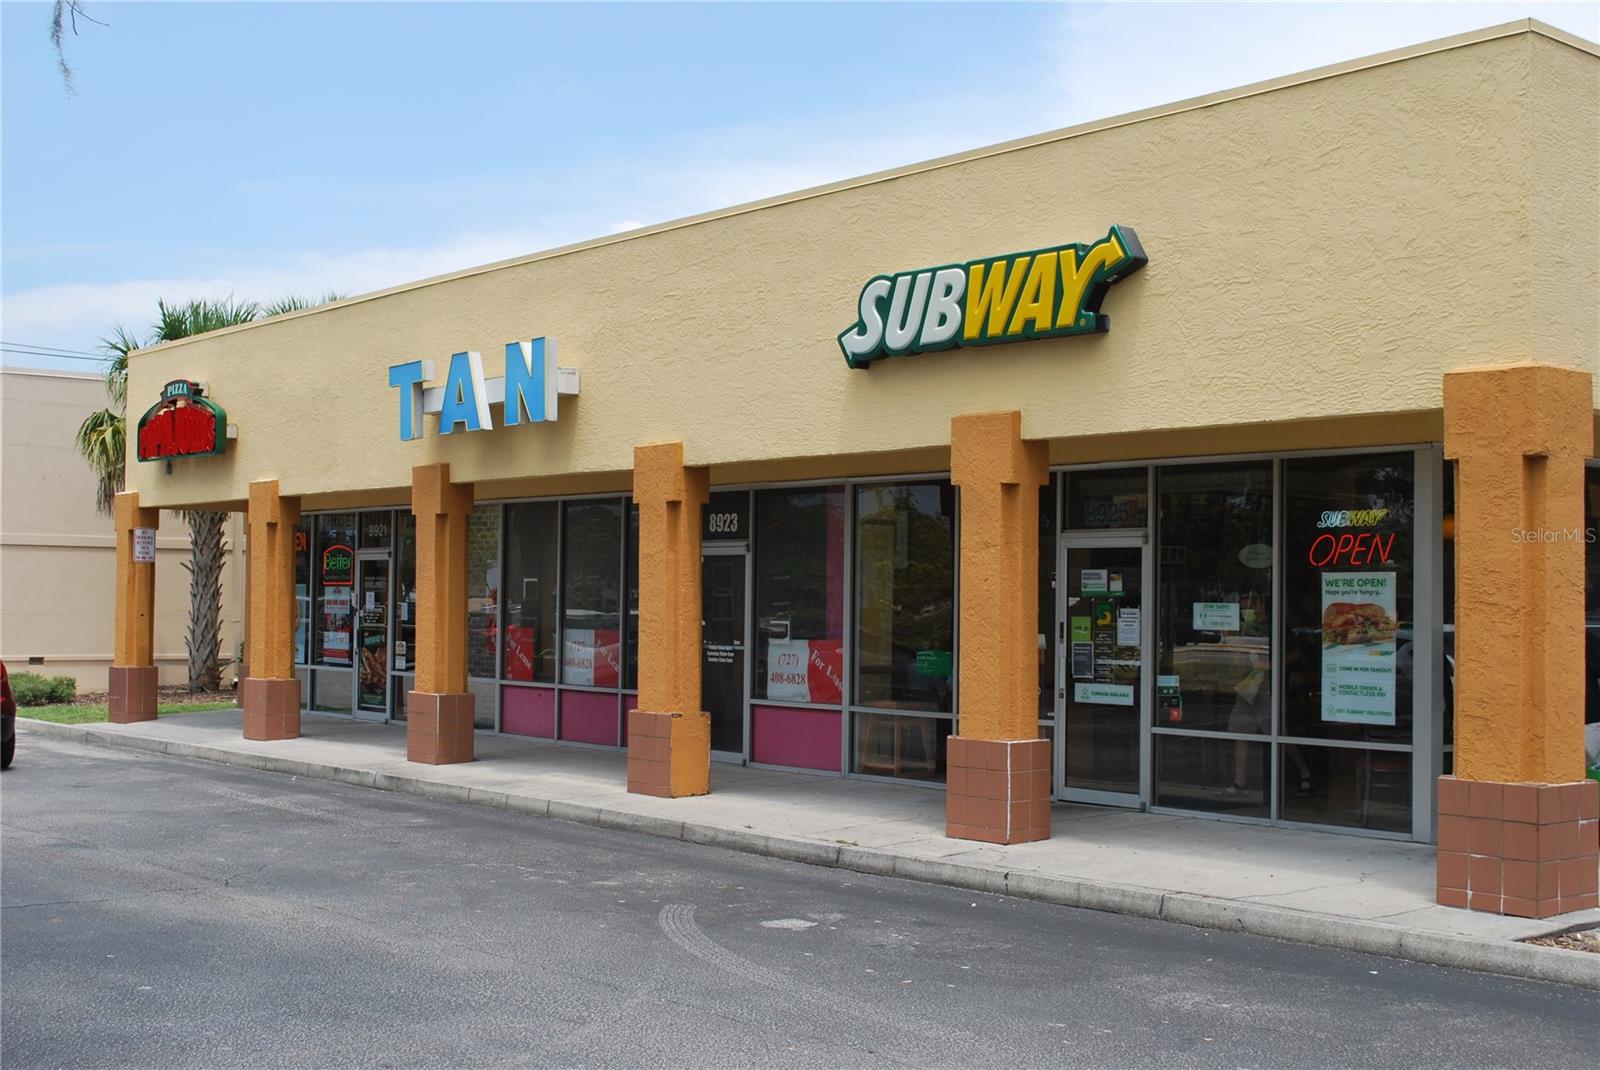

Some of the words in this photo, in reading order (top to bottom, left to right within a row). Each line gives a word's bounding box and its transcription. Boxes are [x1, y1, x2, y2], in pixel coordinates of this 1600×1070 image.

[841, 234, 1125, 358] SUBWAY
[167, 383, 187, 396] PIZZA
[389, 337, 552, 441] TAN
[709, 513, 738, 532] 8923
[1086, 503, 1129, 523] 8925
[1316, 509, 1391, 528] SUBWAY
[368, 524, 388, 537] 8921
[1309, 532, 1396, 567] OPEN
[324, 553, 352, 570] Better
[1325, 578, 1354, 587] WE'RE
[1356, 578, 1387, 588] OPEN!
[778, 653, 799, 666] (727)
[811, 649, 825, 670] For
[770, 671, 806, 685] 408-6828
